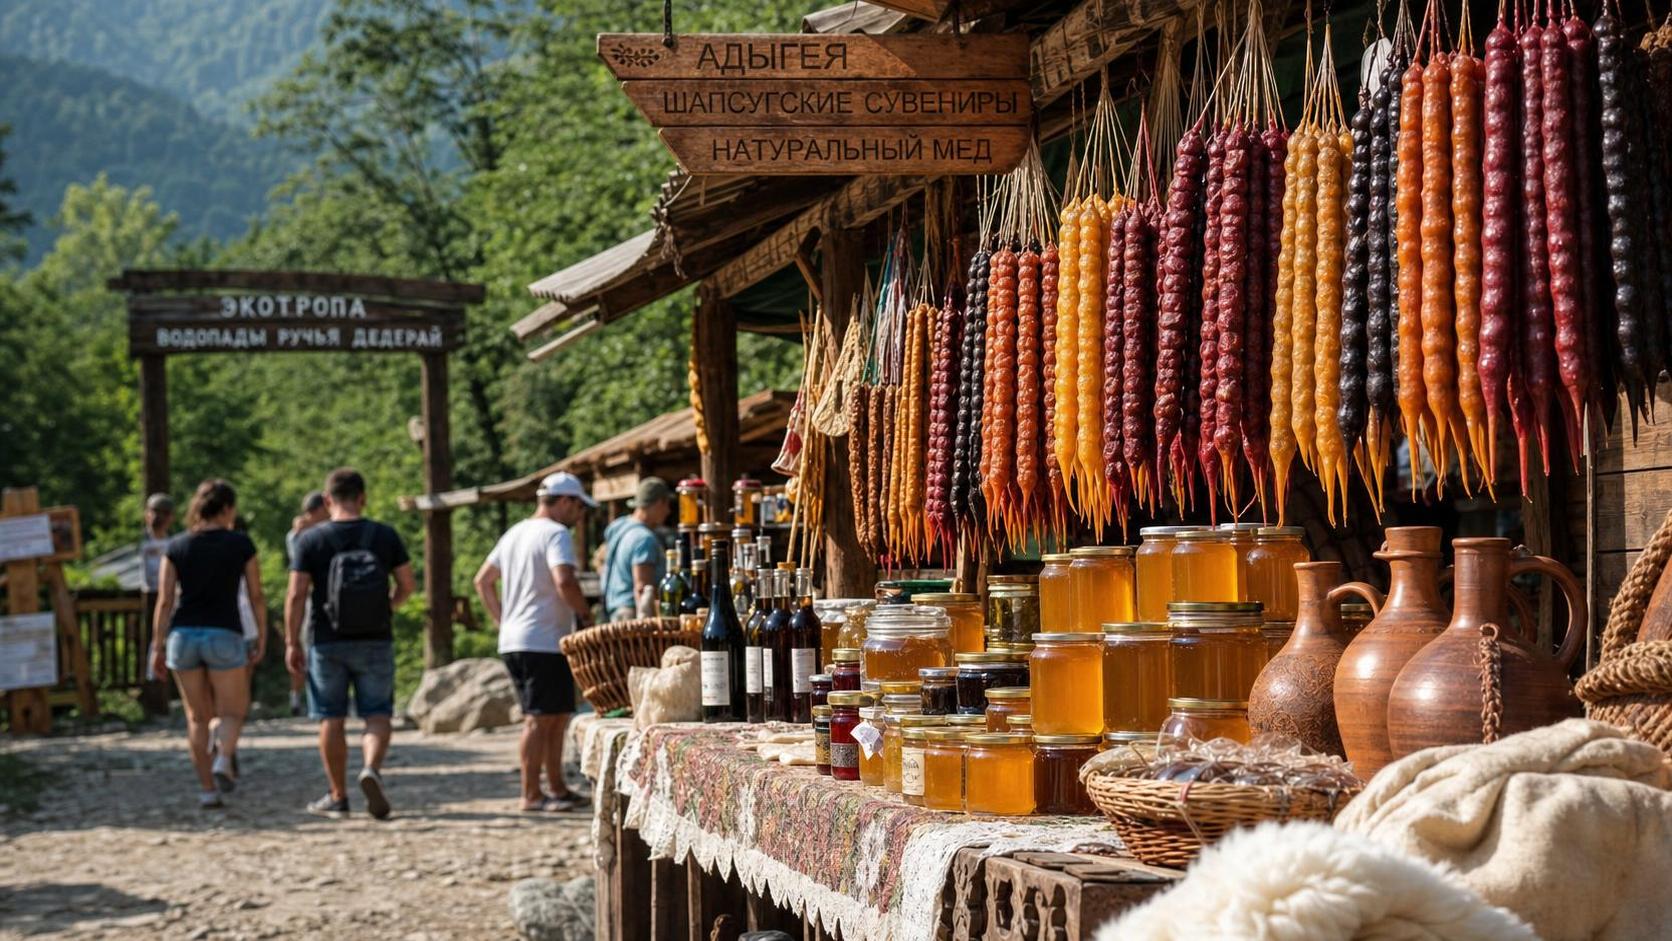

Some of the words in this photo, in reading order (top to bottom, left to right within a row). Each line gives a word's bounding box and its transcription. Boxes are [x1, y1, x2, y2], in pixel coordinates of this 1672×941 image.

[696, 42, 848, 75] АДЫГЕЯ
[663, 90, 853, 115] ШАПСУГСКИЕ
[864, 90, 1018, 115] СУВЕНИРЫ
[712, 133, 924, 162] НАТУРАЛЬНЫЙ
[933, 138, 993, 164] МЕД
[219, 295, 367, 319] ЭКОТРОПА
[156, 327, 267, 349] ВОДОПАДЫ
[276, 327, 341, 347] РУЧЬЯ
[352, 325, 443, 349] ДЕДЕРАЙ
